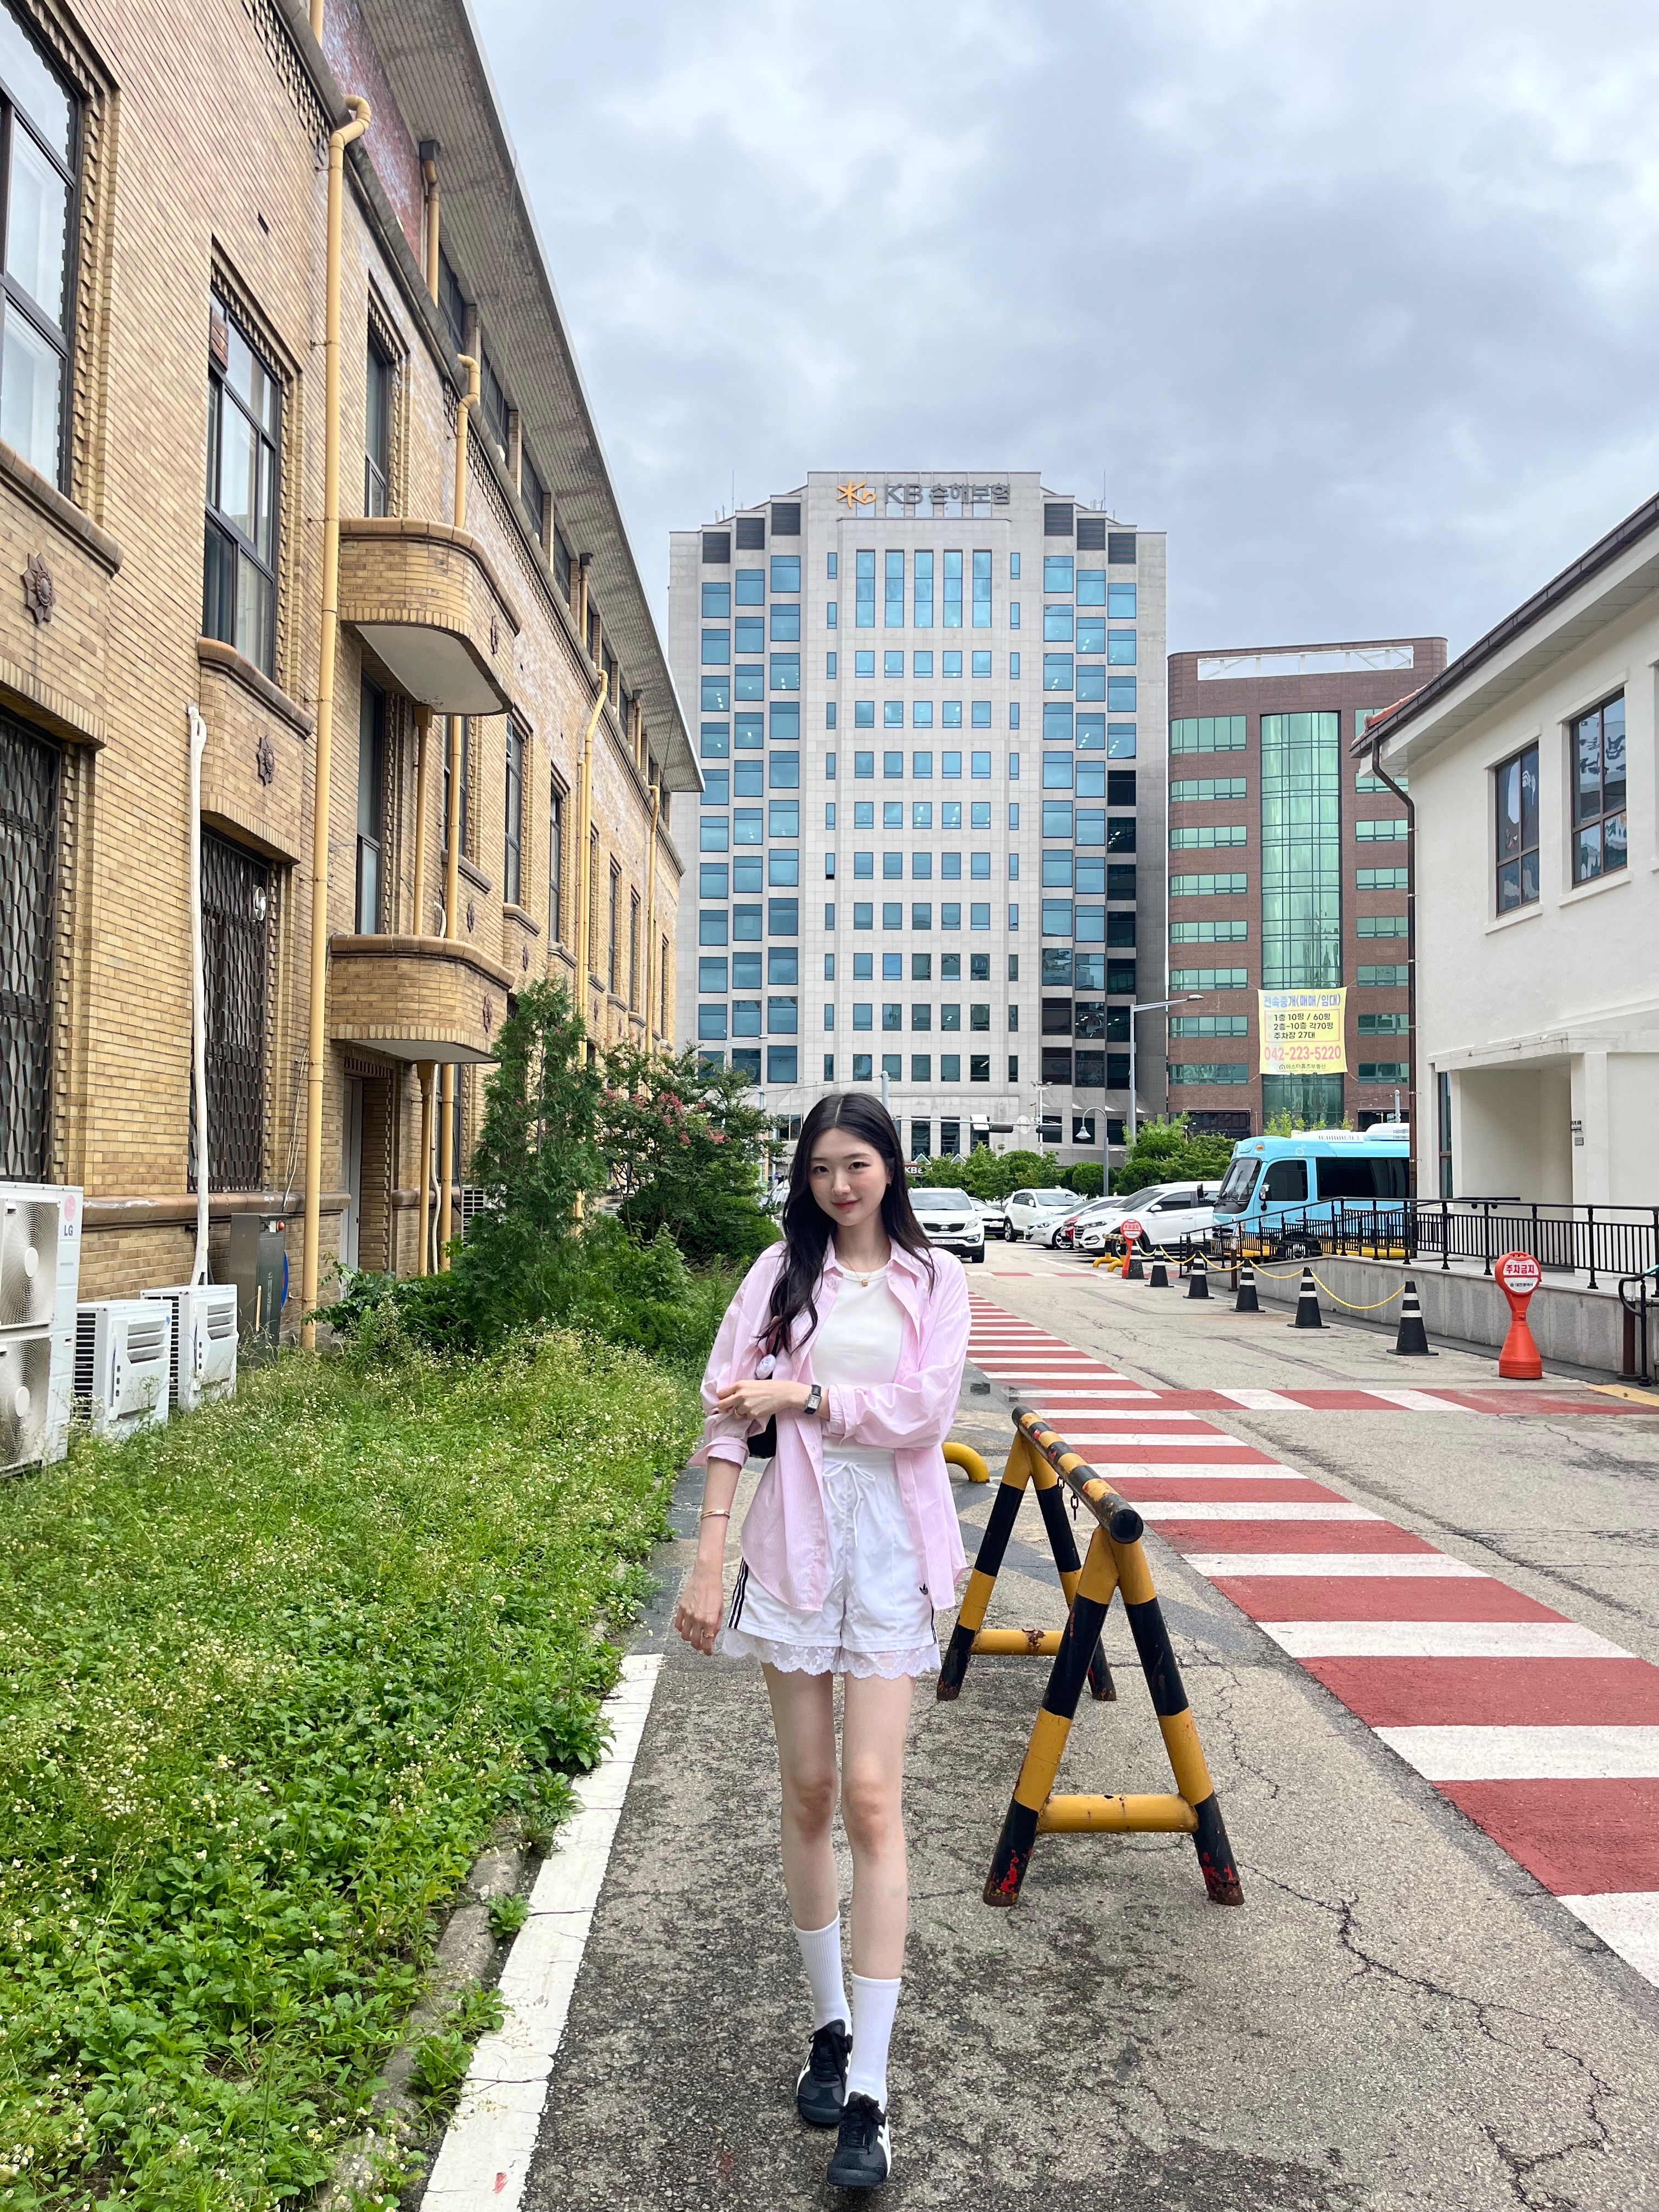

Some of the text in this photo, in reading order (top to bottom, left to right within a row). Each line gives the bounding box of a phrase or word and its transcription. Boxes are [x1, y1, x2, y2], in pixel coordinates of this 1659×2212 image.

[1263, 994, 1341, 1008] 전속중개(매매/임대)
[1264, 1045, 1341, 1061] 042-223-5220
[64, 1224, 73, 1236] LG
[1506, 1265, 1534, 1274] 주차금지
